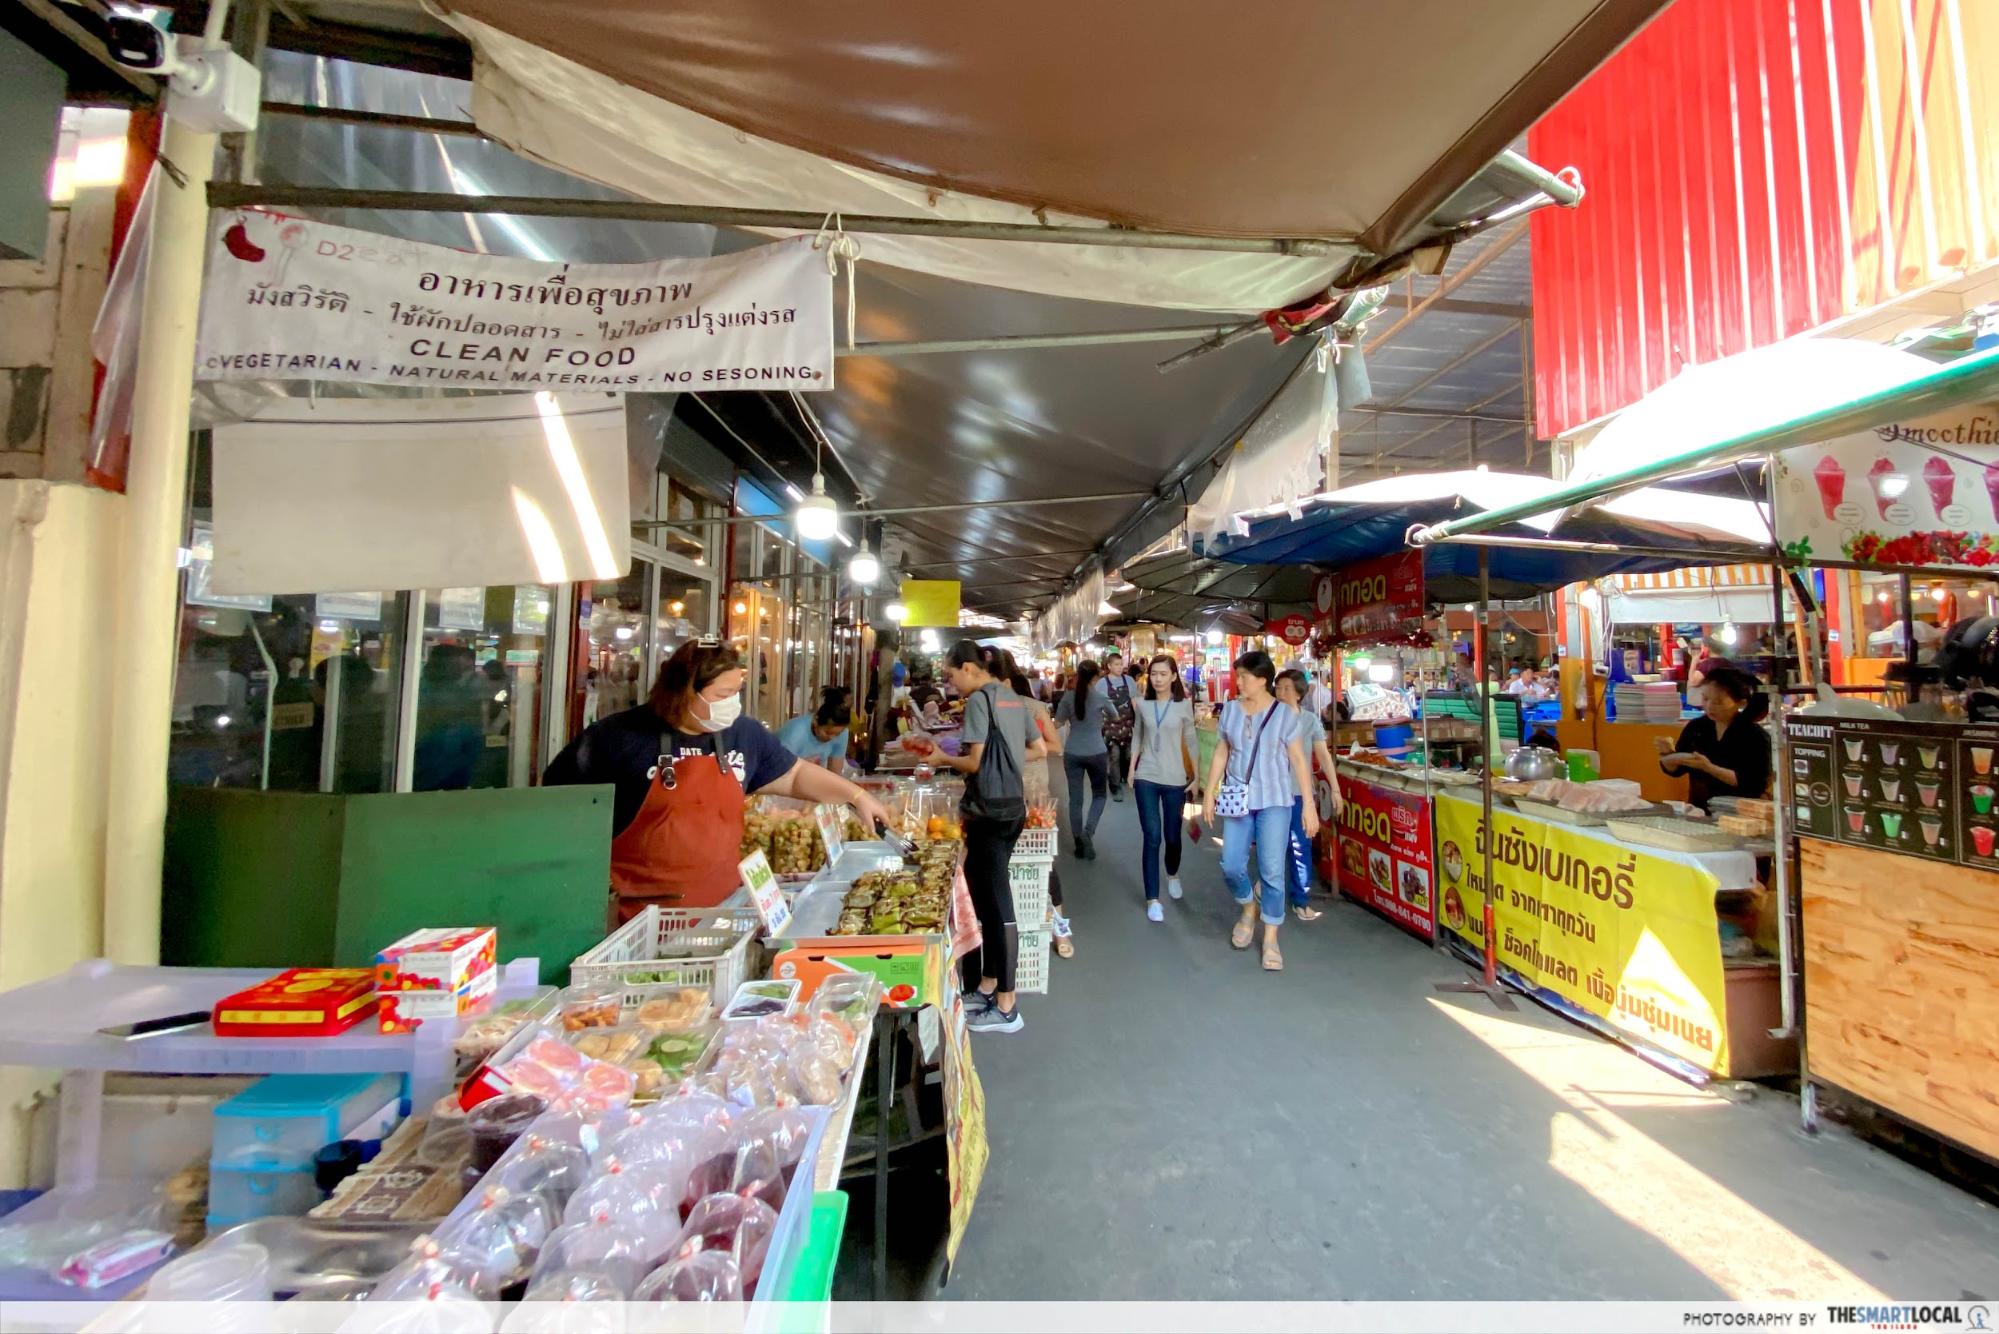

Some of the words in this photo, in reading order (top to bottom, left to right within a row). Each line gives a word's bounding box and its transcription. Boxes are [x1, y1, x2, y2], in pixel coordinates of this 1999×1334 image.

[247, 282, 350, 314] มังสวิรัติ
[390, 302, 561, 339] ใช้ผักปลอดสาร
[598, 303, 797, 342] ไม่ใส่สารปรุงแต่งรส
[419, 264, 693, 315] อาหารเพื่อสุขภาพ
[219, 353, 361, 372] VEGETARIAN
[389, 363, 500, 383] NATURAL
[510, 370, 640, 386] MATERIALS
[663, 370, 692, 383] NO
[702, 365, 812, 382] SESONING
[410, 338, 529, 363] CLEAN
[545, 346, 636, 368] FOOD
[1334, 787, 1391, 844] ก่ทอด
